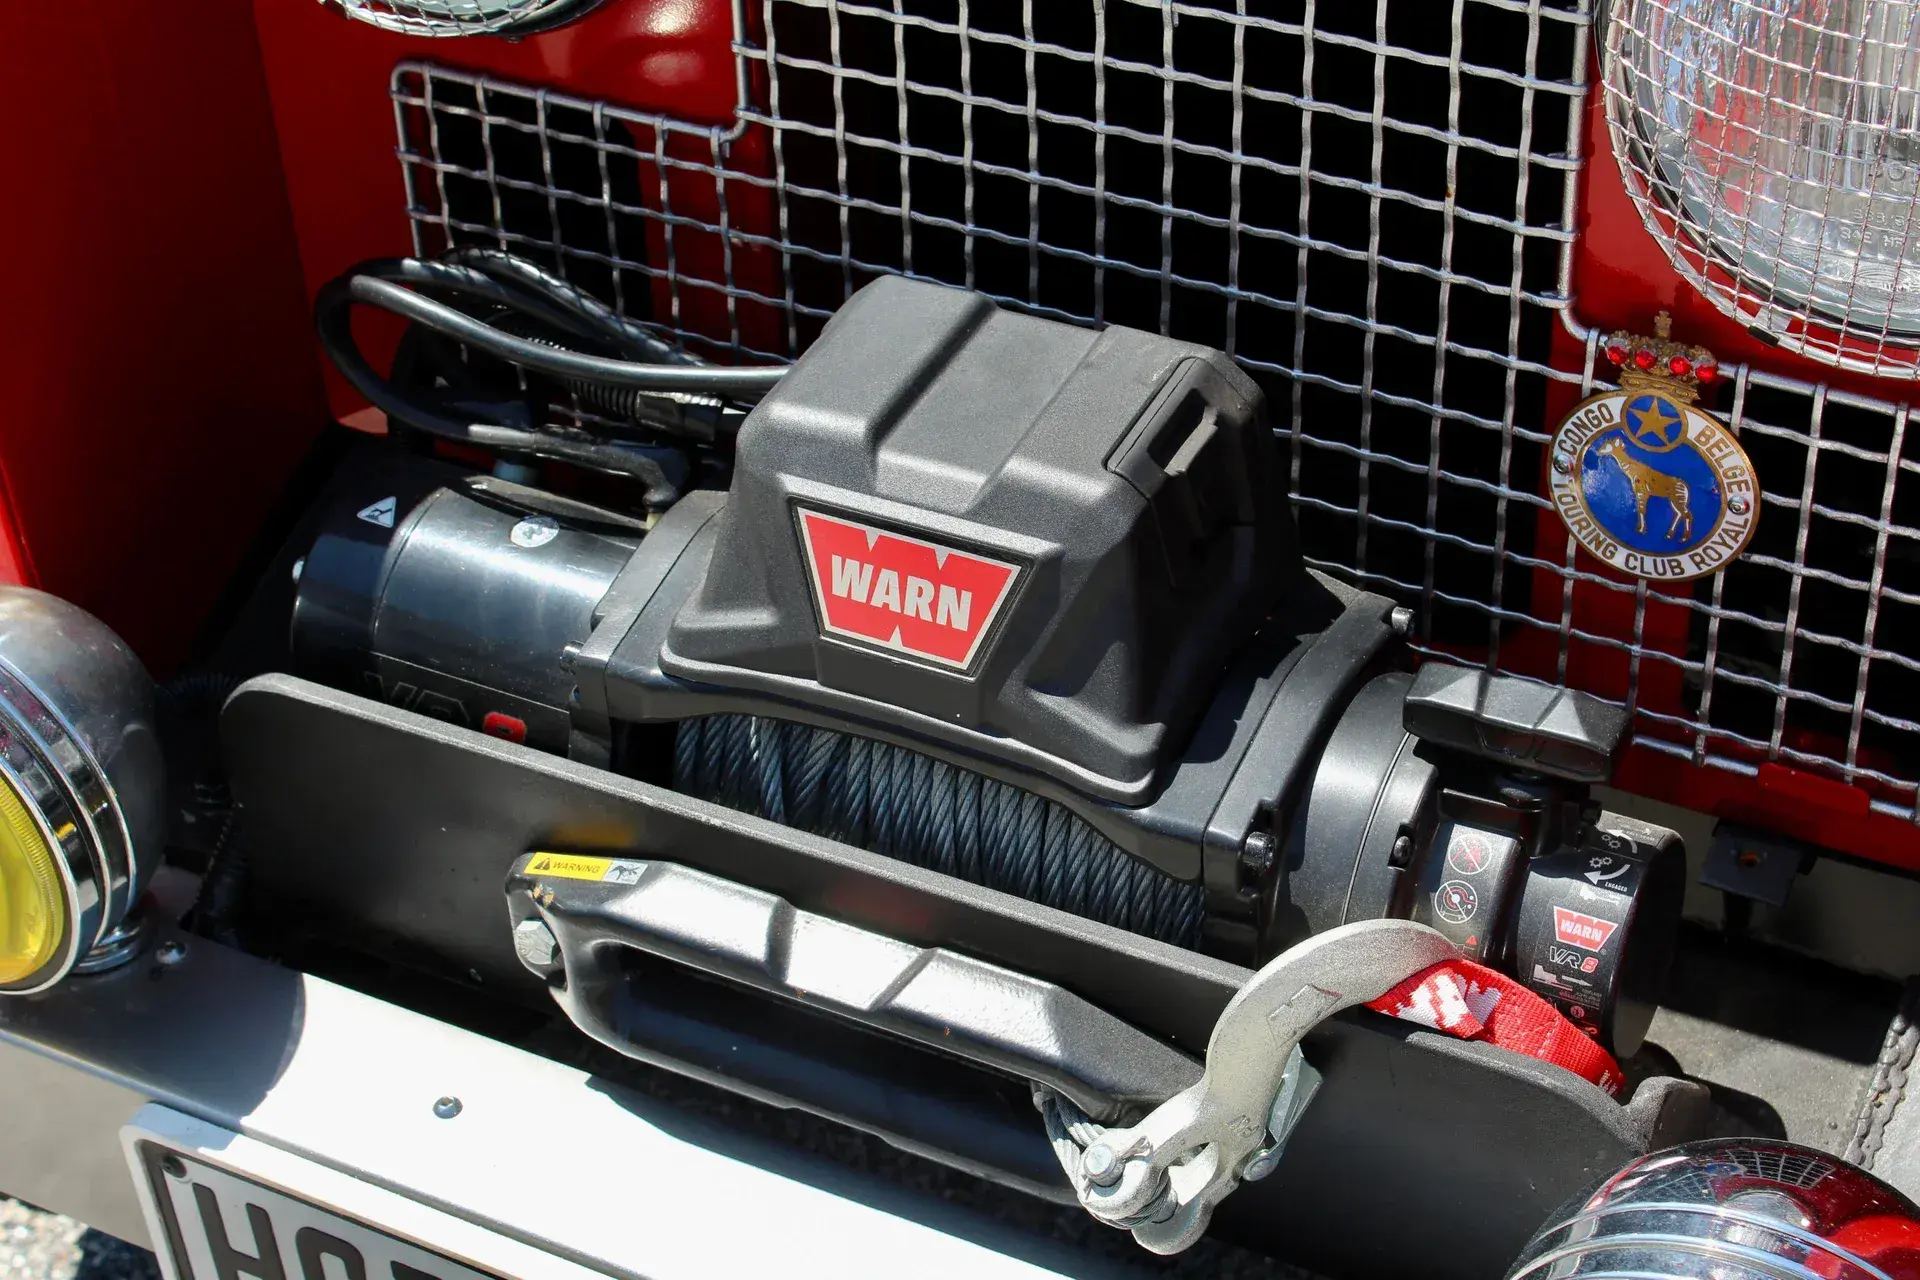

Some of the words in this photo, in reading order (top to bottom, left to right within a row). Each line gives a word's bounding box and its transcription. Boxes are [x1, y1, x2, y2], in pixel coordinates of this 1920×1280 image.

[1557, 402, 1614, 455] CONGO
[1694, 425, 1750, 494] BELGE
[1554, 479, 1618, 560] TOURING
[1625, 552, 1685, 577] CLUB
[1689, 518, 1750, 571] ROYAL
[831, 554, 972, 632] WARN
[552, 860, 600, 874] WARNING
[1560, 919, 1602, 941] WARN
